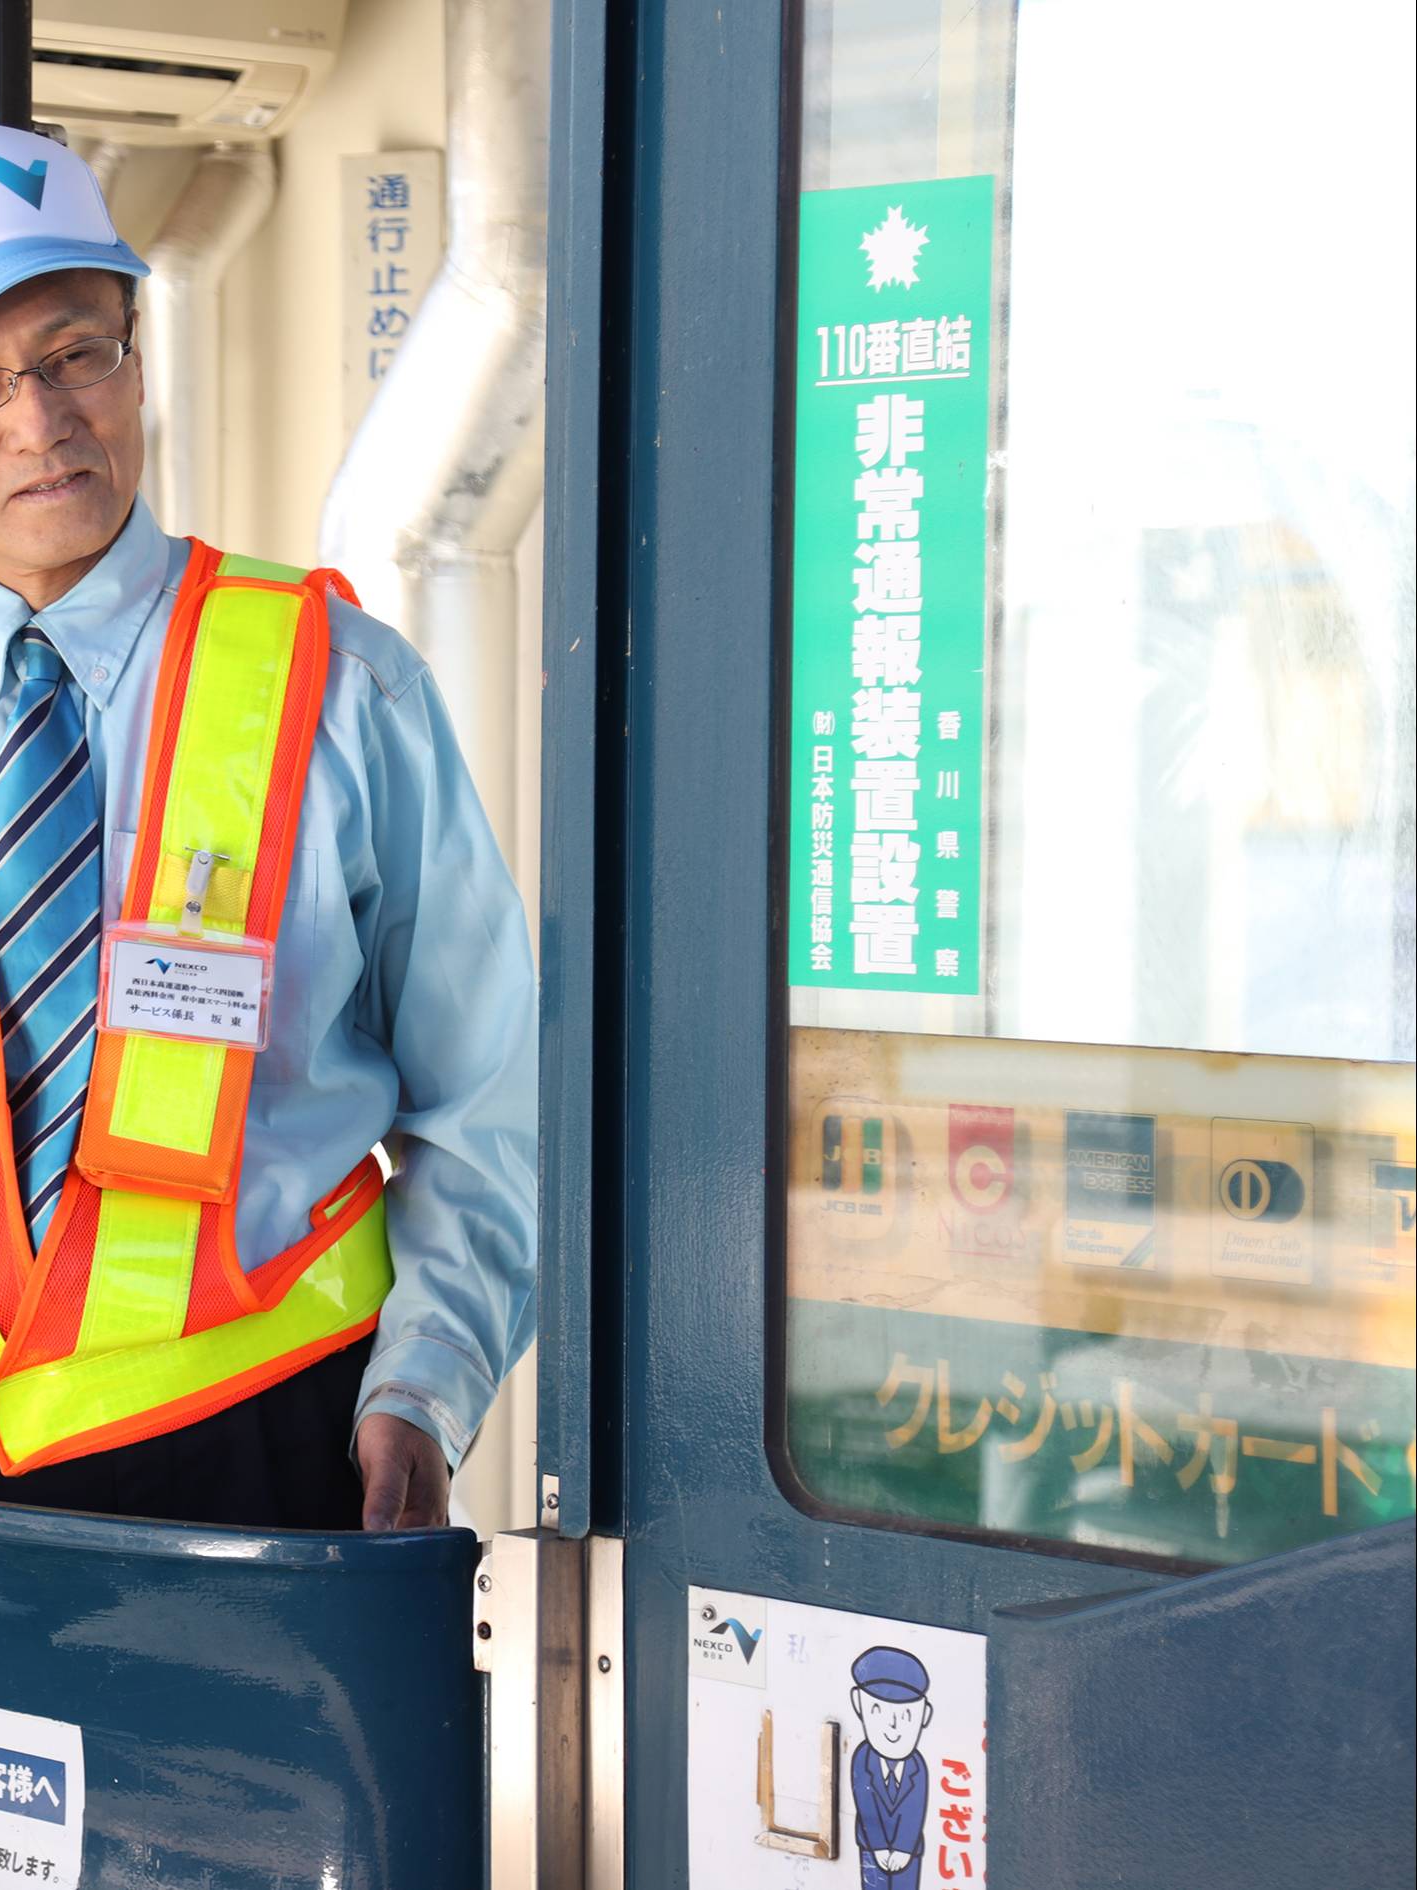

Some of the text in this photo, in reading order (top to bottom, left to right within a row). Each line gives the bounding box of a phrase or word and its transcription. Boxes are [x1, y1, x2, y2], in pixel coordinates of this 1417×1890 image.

[817, 315, 972, 377] 110番直結
[849, 394, 924, 974] 非常通報装置設置
[935, 711, 961, 977] 香川県警察
[174, 962, 208, 971] NEXCO
[130, 1004, 195, 1021] サービス係長
[1067, 1150, 1150, 1172] AMERICAN
[1084, 1172, 1155, 1194] EXPRESS
[877, 1352, 1382, 1516] クレジットカード
[693, 1639, 733, 1653] NEXCO
[938, 1759, 973, 1890] ござい
